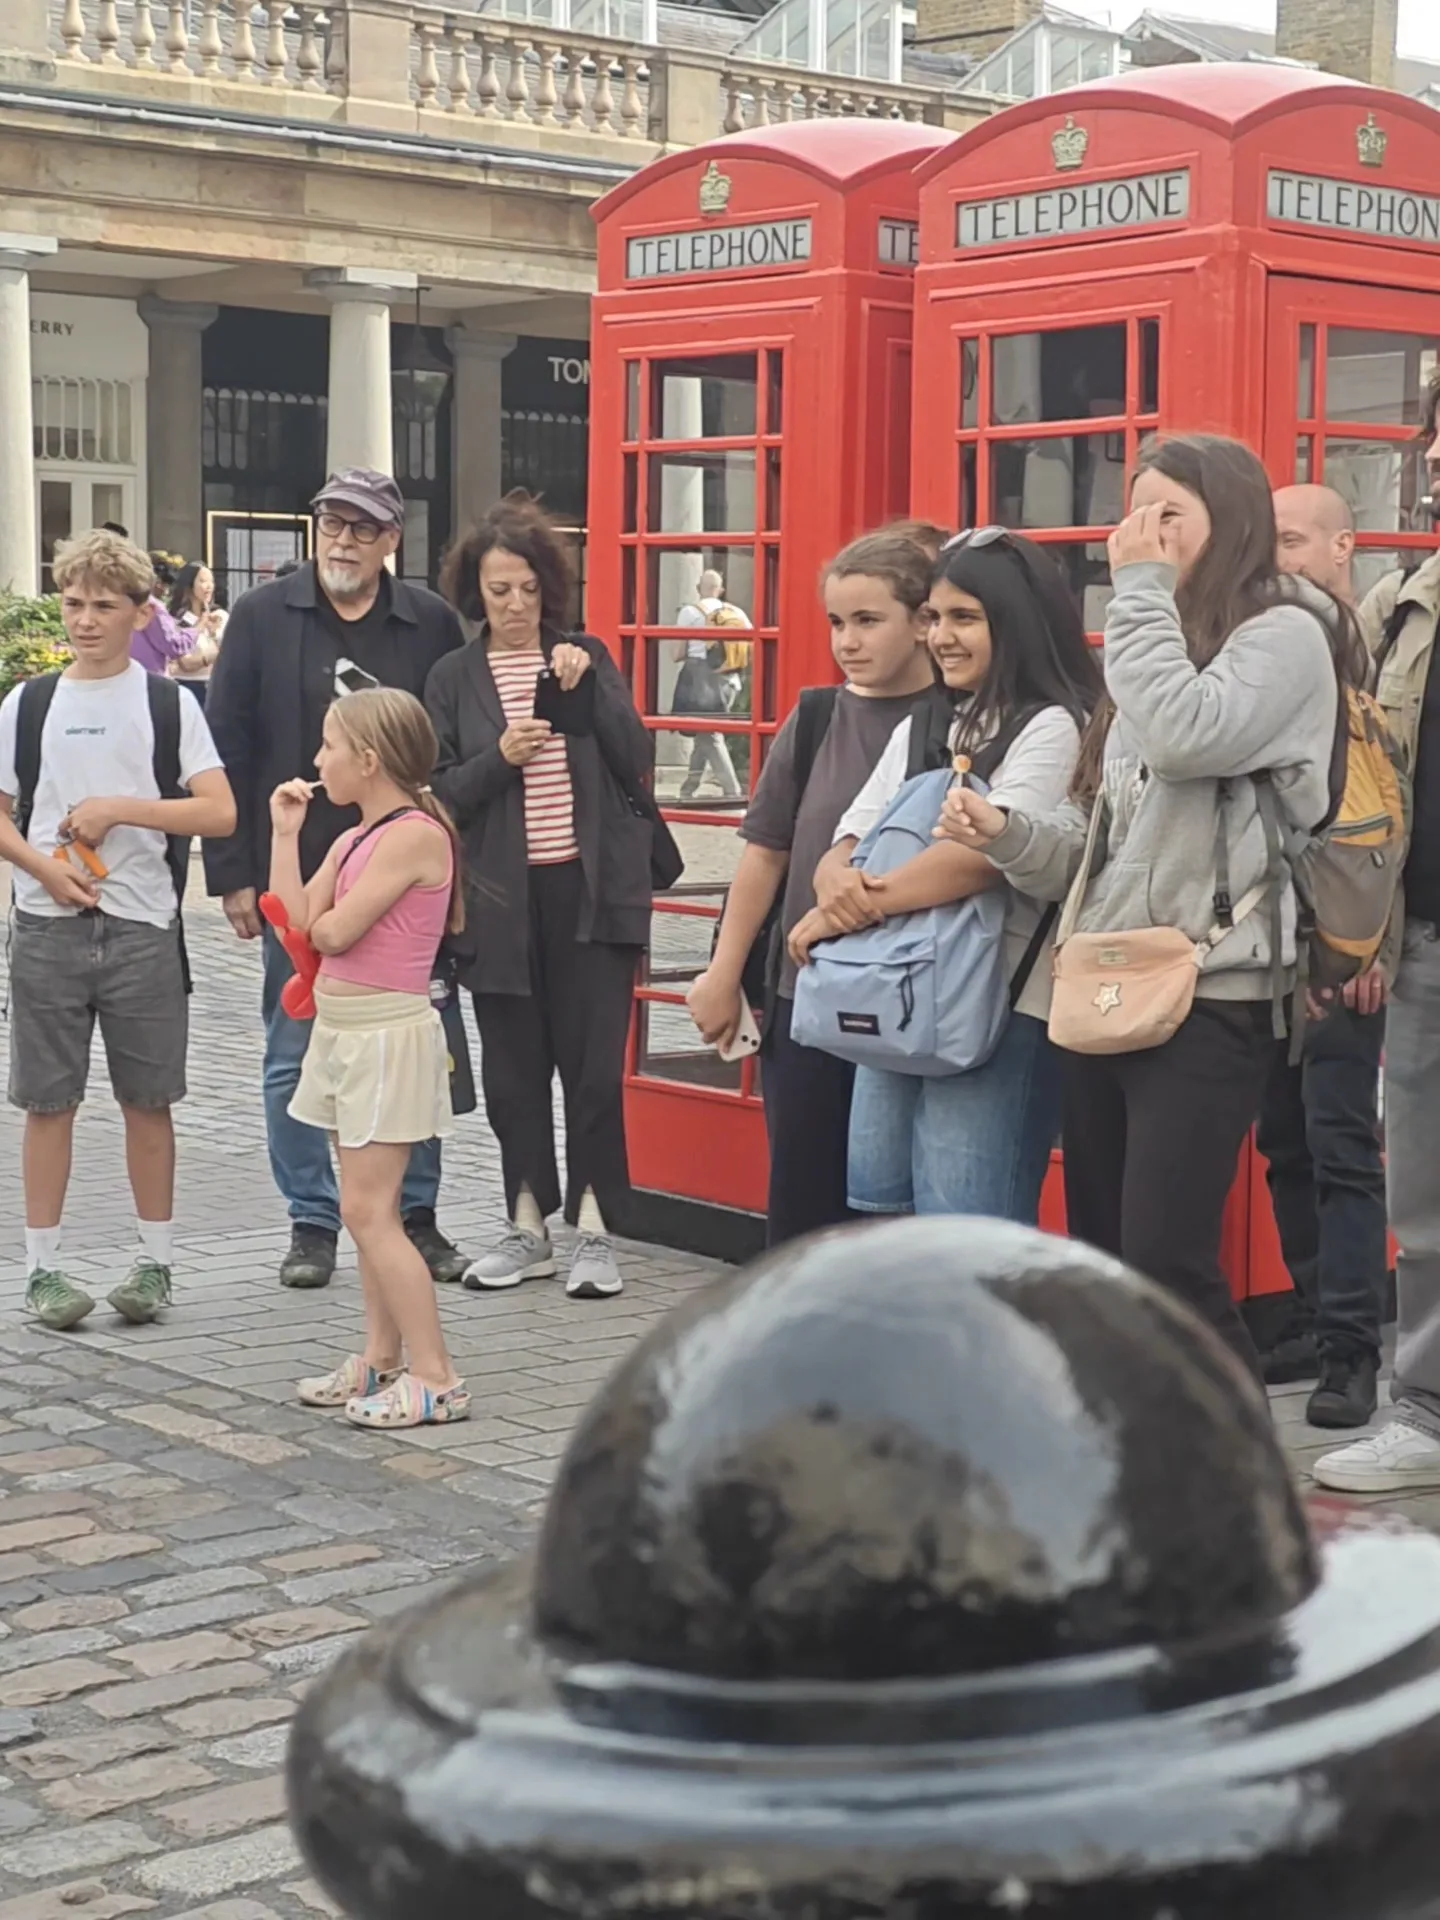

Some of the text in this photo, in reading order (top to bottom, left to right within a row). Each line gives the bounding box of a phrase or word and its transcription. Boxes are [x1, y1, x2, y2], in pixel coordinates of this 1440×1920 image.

[964, 175, 1183, 242] TELEPHONE
[1271, 176, 1440, 239] TELEPHON
[636, 223, 808, 276] TELEPHONE
